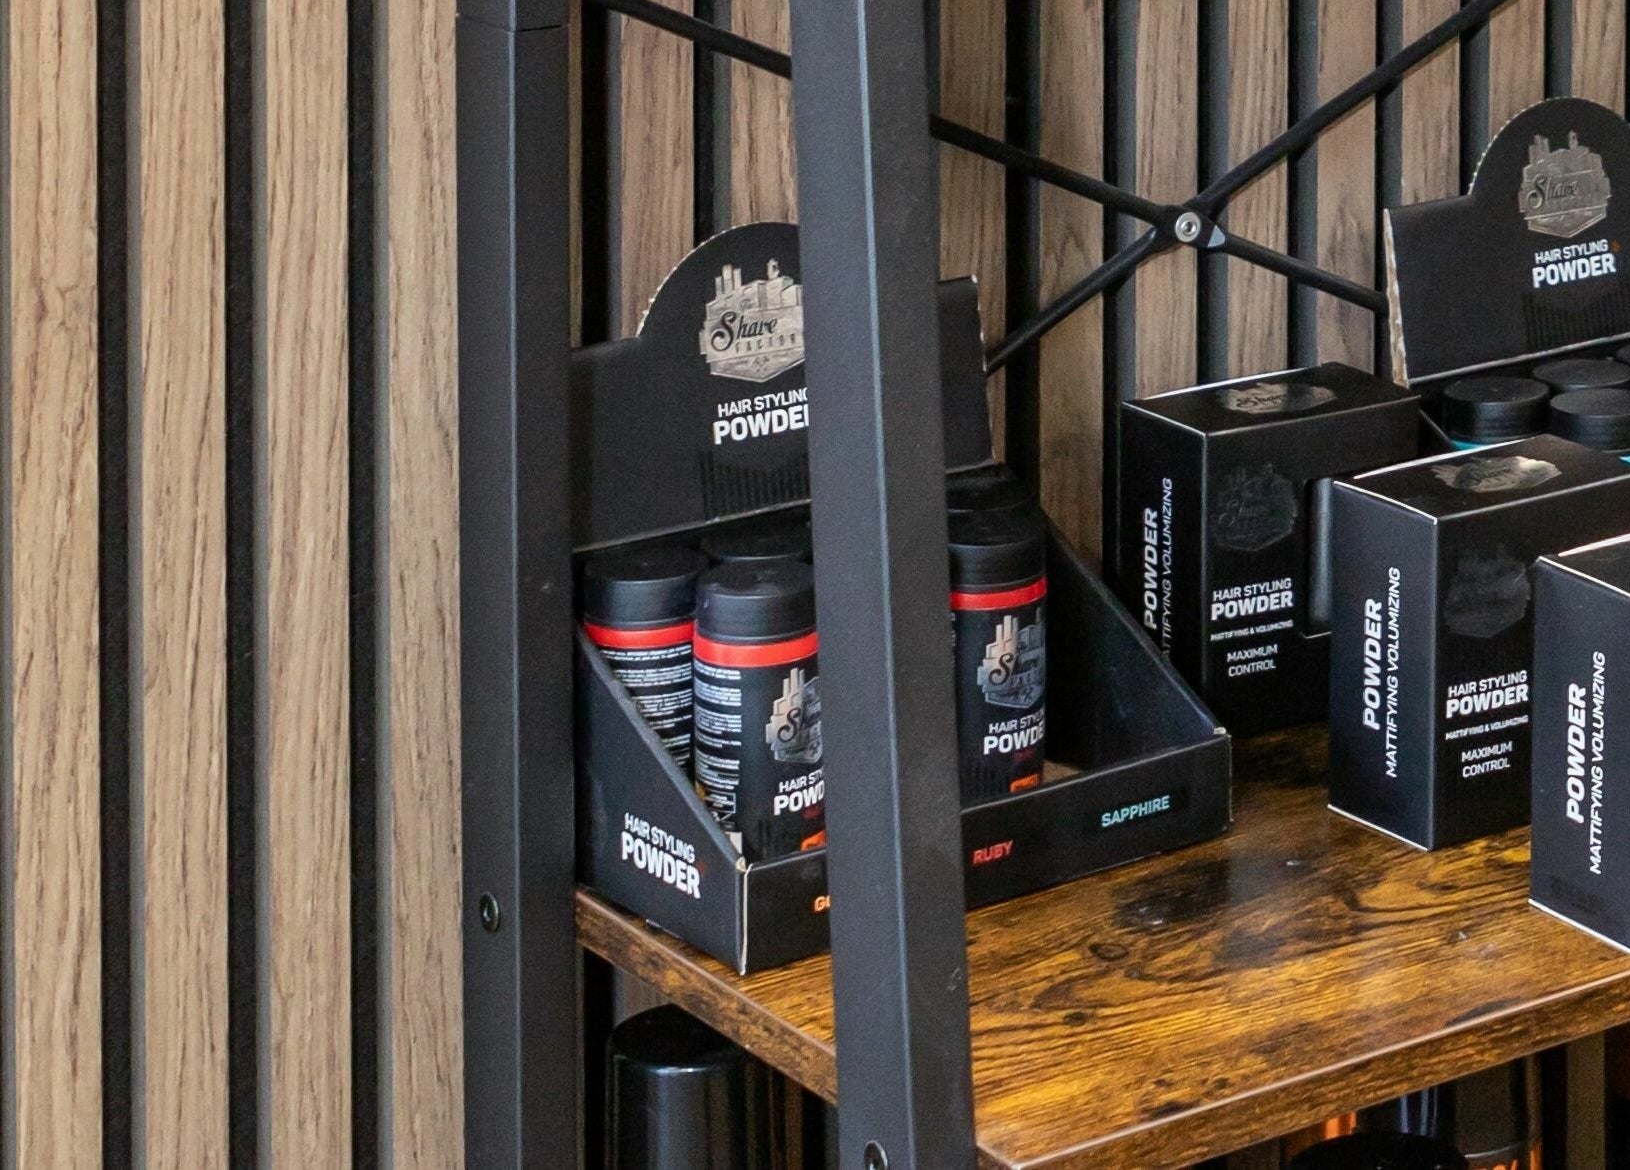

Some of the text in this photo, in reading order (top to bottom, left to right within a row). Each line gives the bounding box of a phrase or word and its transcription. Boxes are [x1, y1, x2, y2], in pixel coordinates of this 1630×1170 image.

[1534, 239, 1608, 264] HAIR STYLING
[1532, 252, 1617, 288] POWDER
[718, 399, 752, 417] HAIR
[1162, 478, 1173, 575] VOLUMIZING
[1143, 507, 1158, 630] POWDER
[1211, 590, 1294, 621] POWDER
[1213, 577, 1292, 601] HAIR STYLING
[1227, 643, 1278, 662] MAXIMUM
[1228, 659, 1276, 677] CONTROL
[1363, 598, 1383, 730] POWDER
[1385, 566, 1401, 778] MATTIFYING VOLUMIZING
[1448, 669, 1527, 698] HAIR STYLING
[1446, 683, 1529, 719] POWDER
[989, 719, 1017, 734] HAIR
[1461, 740, 1513, 763] MAXIMUM
[1462, 758, 1511, 778] CONTROL
[1567, 683, 1587, 824] POWDER
[1589, 651, 1606, 875] MATTIFYING VOLUMIZING
[779, 775, 807, 793] HAIR
[624, 812, 695, 863] HAIR STYLING
[973, 795, 1170, 865] RUBY SAPPHIRE
[621, 831, 701, 899] POWDER
